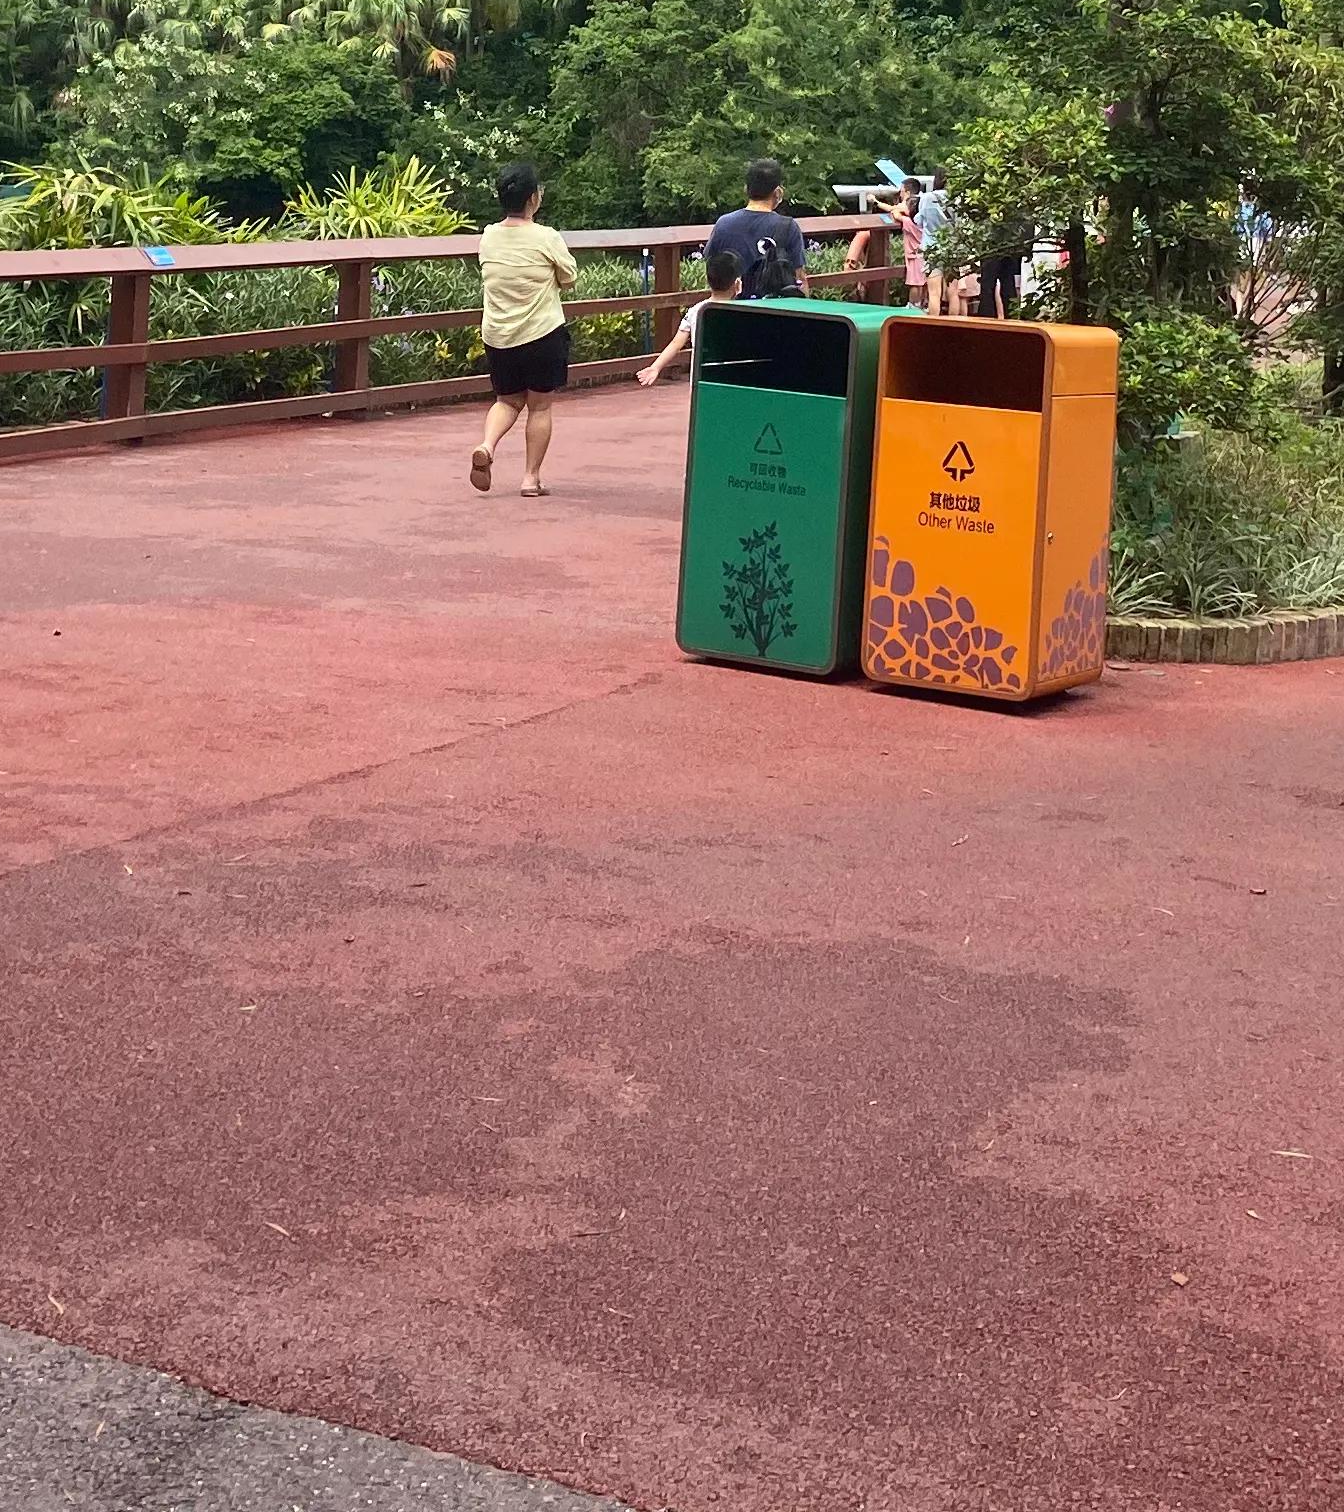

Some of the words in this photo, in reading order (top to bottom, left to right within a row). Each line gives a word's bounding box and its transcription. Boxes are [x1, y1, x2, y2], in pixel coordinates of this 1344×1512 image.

[929, 491, 981, 514] 其他垃圾
[918, 511, 952, 529] Other
[955, 515, 995, 534] Waste
